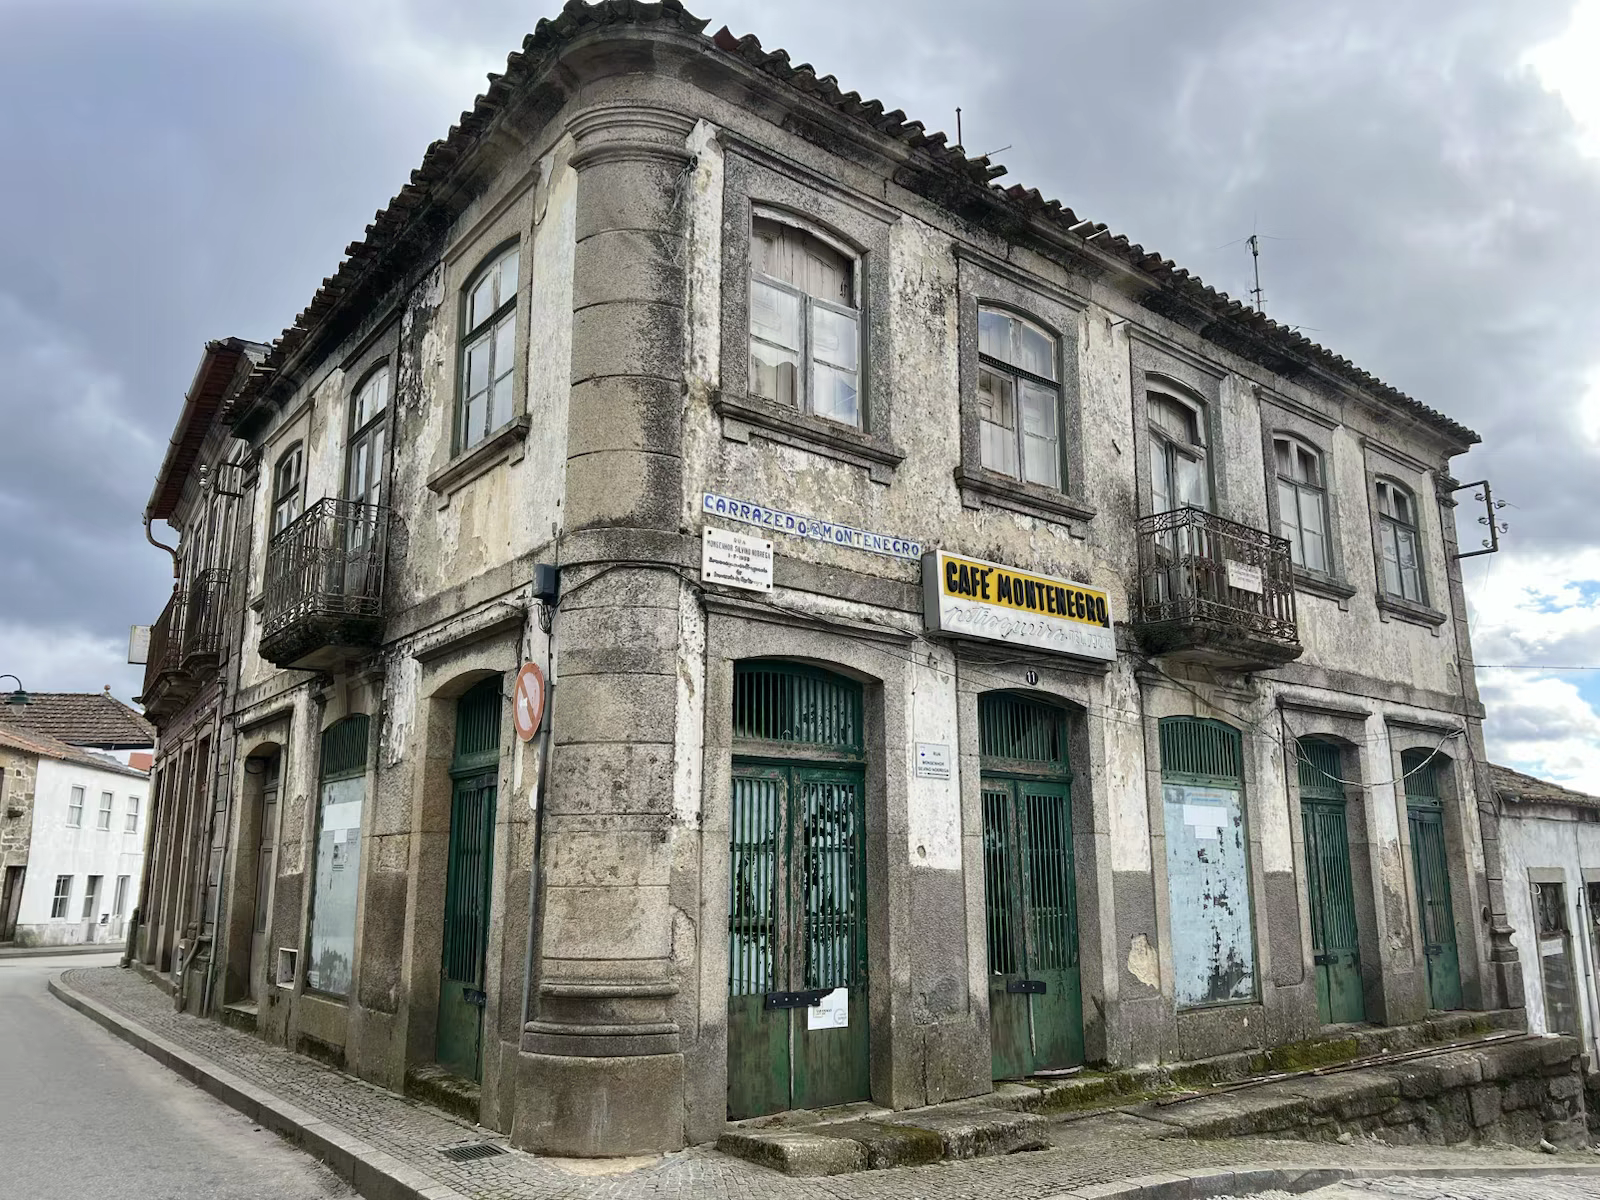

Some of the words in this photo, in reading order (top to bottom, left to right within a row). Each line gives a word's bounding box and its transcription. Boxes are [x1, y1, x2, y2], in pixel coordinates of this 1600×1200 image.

[704, 494, 807, 535] CARRAZEDO
[823, 525, 919, 556] MONTENEGRO
[733, 537, 746, 545] RUA
[946, 561, 994, 600] CAFÉ
[997, 573, 1107, 624] MONTENEGRO
[1027, 671, 1035, 683] 11
